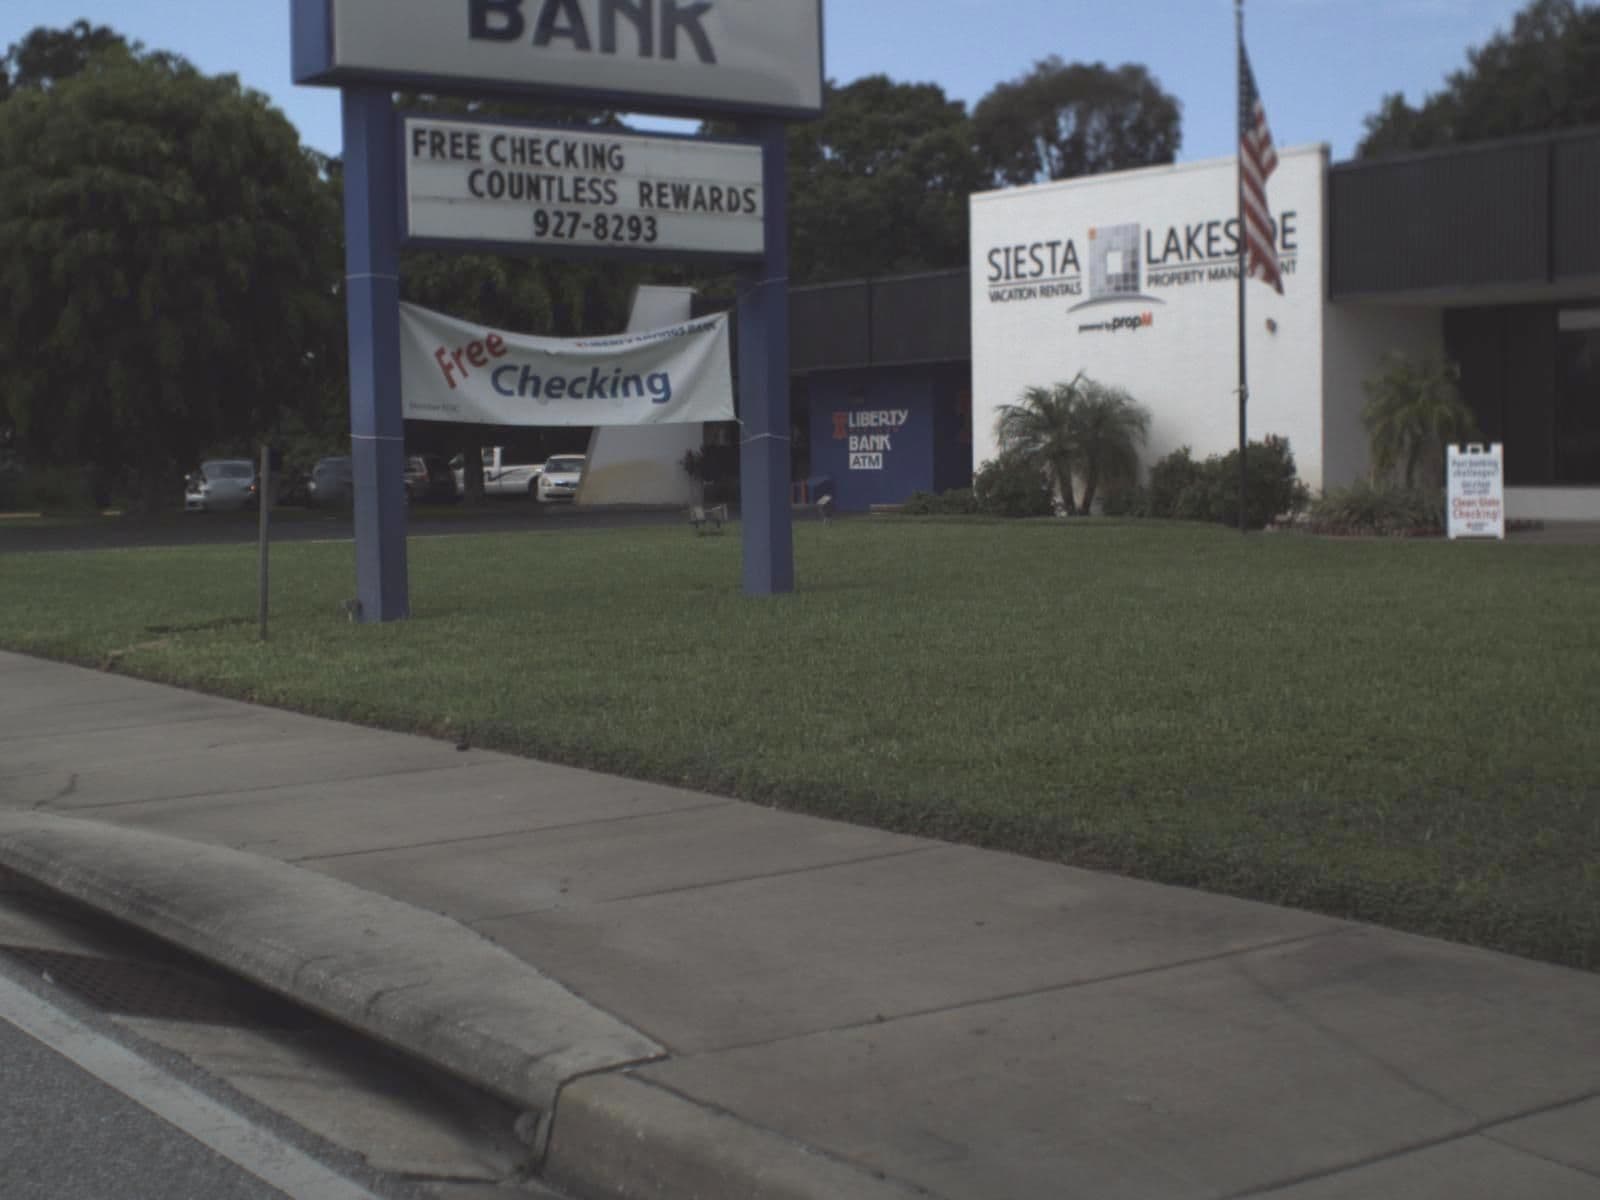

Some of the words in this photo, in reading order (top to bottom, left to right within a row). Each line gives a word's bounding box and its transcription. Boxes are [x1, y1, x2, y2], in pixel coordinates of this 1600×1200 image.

[468, 0, 718, 64] BANK
[412, 128, 482, 161] FREE
[491, 134, 625, 171] CHECKING
[468, 169, 618, 205] COUNTLESS
[639, 181, 757, 214] REWARDS
[533, 209, 657, 243] 927-8293
[1146, 211, 1297, 264] LAKESE
[987, 238, 1081, 282] SIESTA
[1146, 269, 1204, 287] PROPERTY
[988, 286, 1036, 303] VACATION
[1039, 282, 1082, 298] RENTALS
[1112, 312, 1153, 332] propM
[433, 331, 507, 390] Free
[490, 364, 672, 404] Checking
[848, 408, 909, 427] LIBERTY
[848, 434, 891, 451] BANK
[852, 455, 880, 467] ATM
